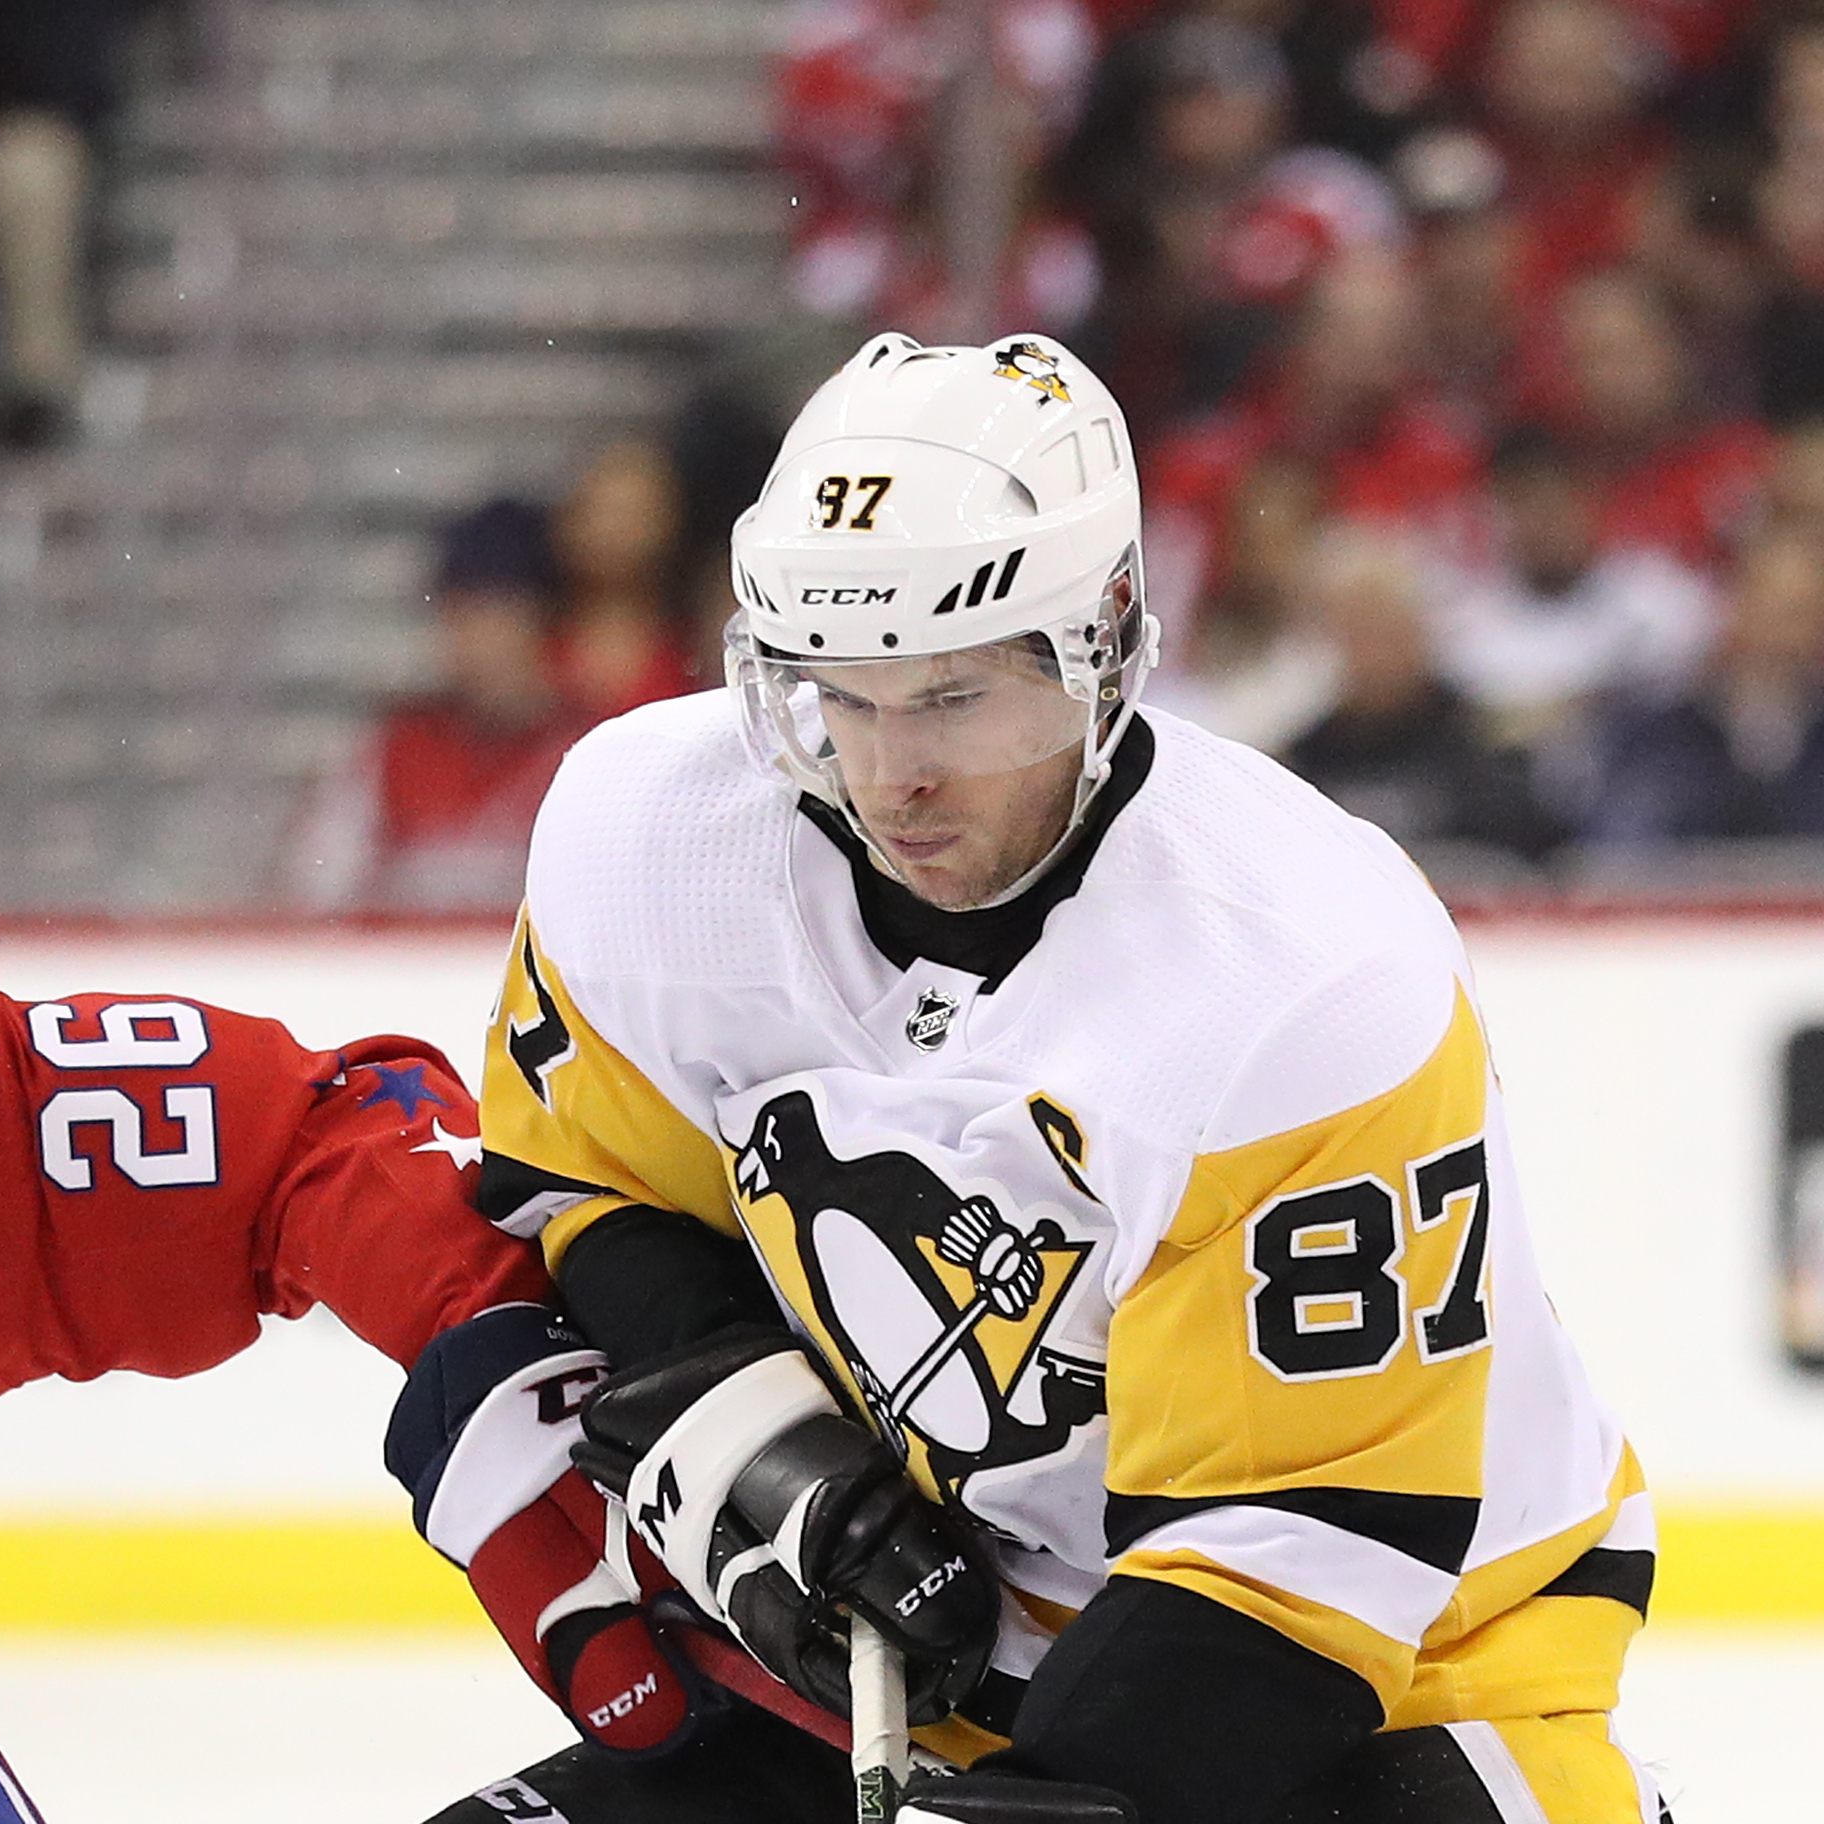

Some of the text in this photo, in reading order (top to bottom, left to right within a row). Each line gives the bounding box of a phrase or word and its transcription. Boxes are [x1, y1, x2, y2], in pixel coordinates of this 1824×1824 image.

[809, 475, 895, 531] 87
[801, 587, 898, 605] CCM
[25, 1000, 221, 1193] 26
[1243, 1136, 1494, 1384] 87
[895, 1555, 967, 1618] CCM
[587, 1672, 657, 1730] CCM
